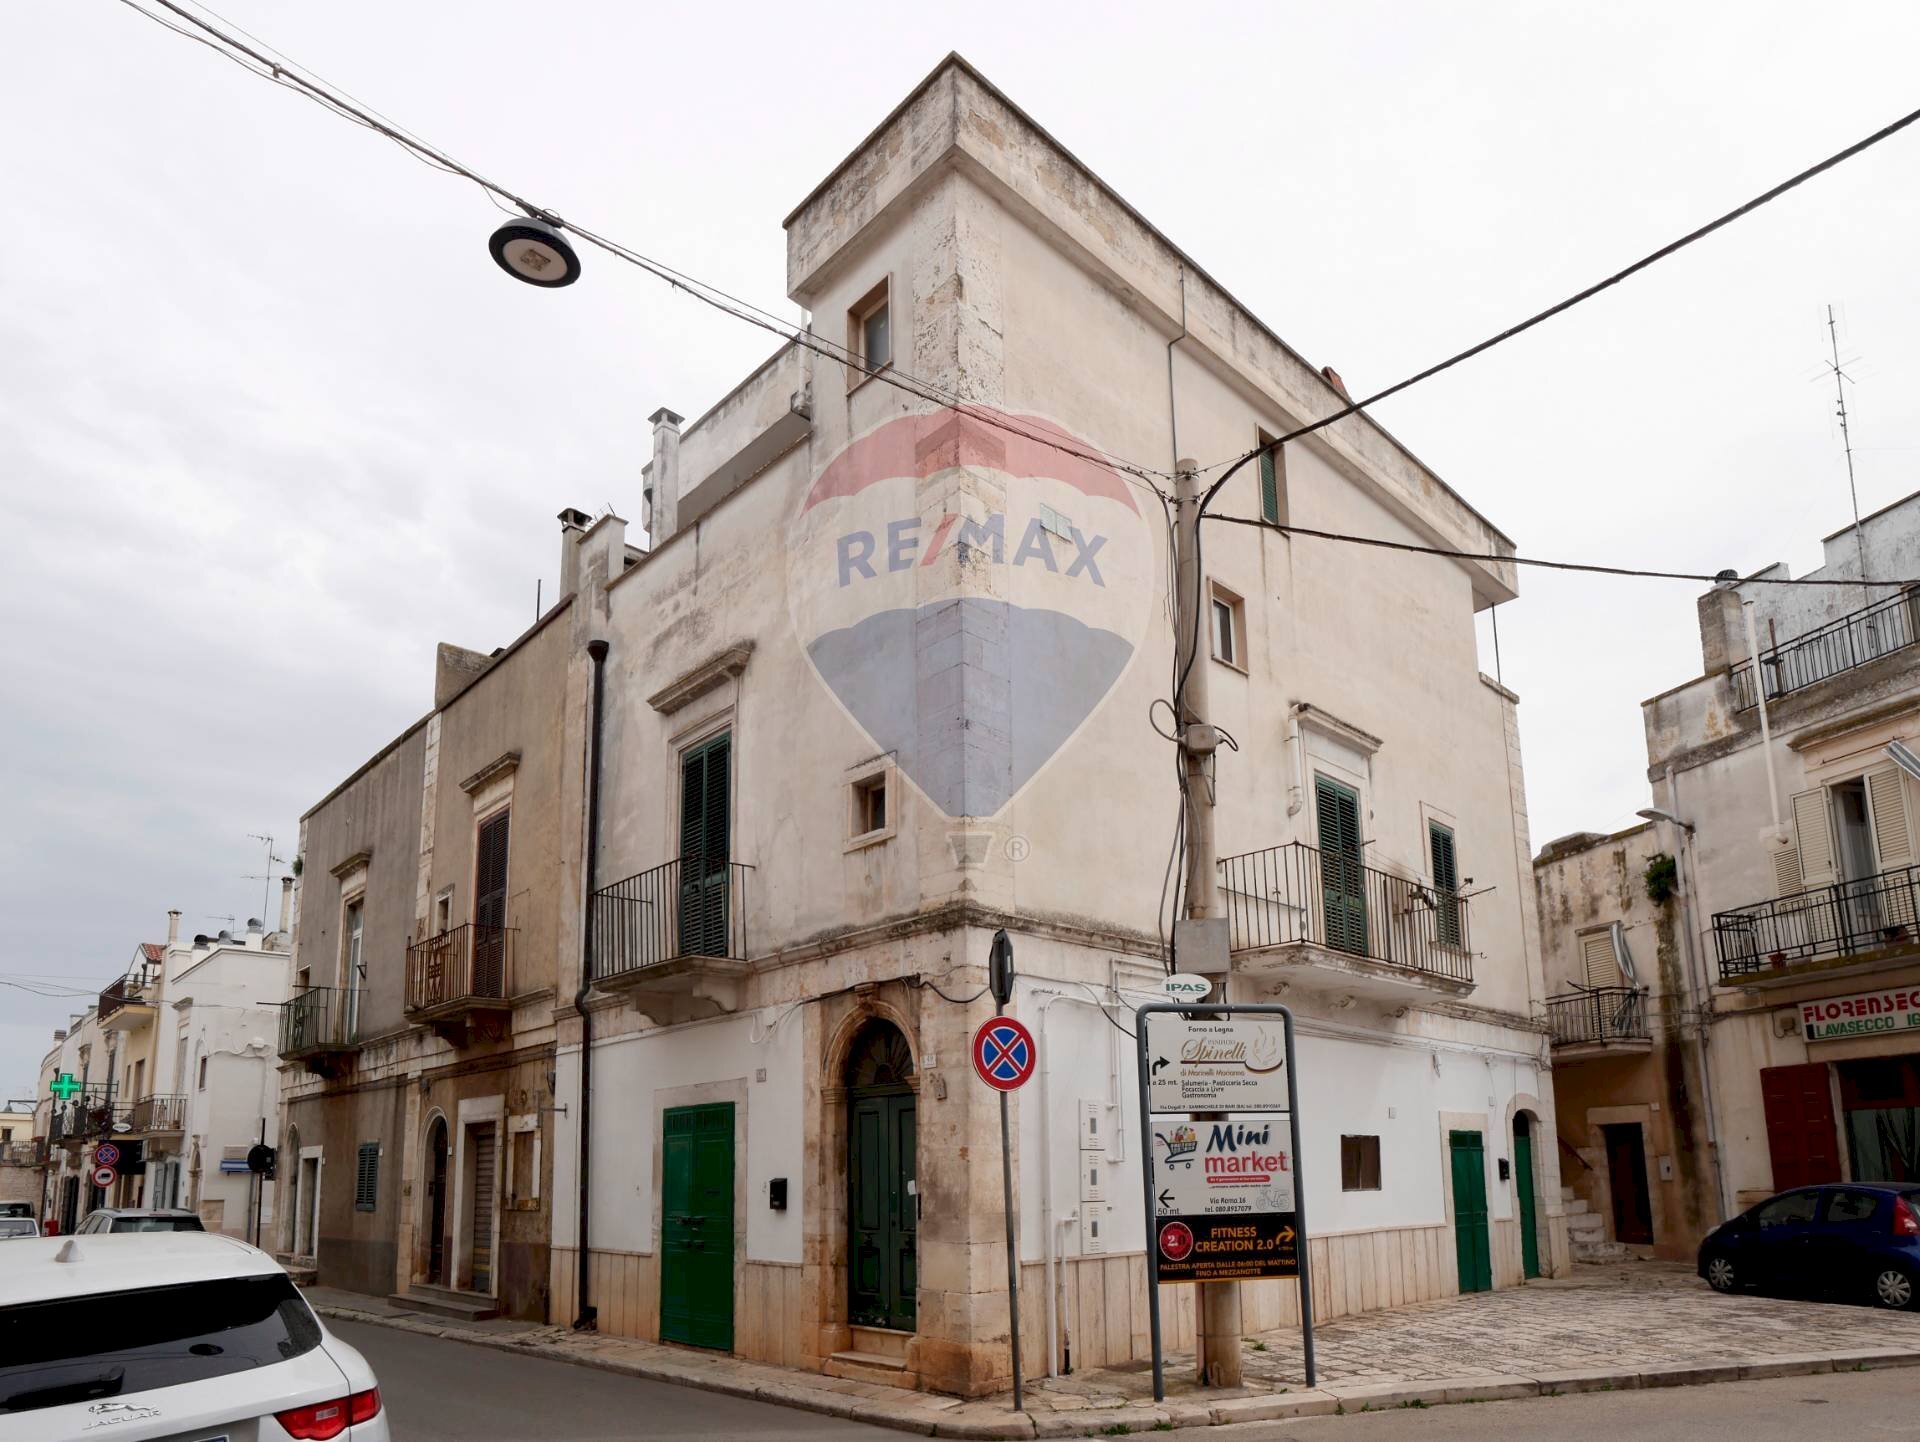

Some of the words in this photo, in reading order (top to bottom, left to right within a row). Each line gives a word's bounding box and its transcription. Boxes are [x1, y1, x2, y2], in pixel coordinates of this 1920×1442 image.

[1166, 983, 1206, 992] IPAS
[1214, 1026, 1234, 1034] Legna
[1816, 1016, 1895, 1037] LAVASECCO
[1181, 1036, 1247, 1066] Spinelli
[1182, 1079, 1208, 1087] Salumeria
[1212, 1079, 1241, 1087] Pasticceria
[1242, 1079, 1258, 1087] Secca
[1206, 1124, 1270, 1153] Mini
[1204, 1151, 1288, 1173] market
[1211, 1226, 1257, 1238] FITNESS
[1195, 1241, 1253, 1252] CREATION
[1257, 1240, 1273, 1250] 2.0
[1160, 1263, 1190, 1271] PALESTRA
[1267, 1258, 1296, 1266] MATTINO
[1219, 1268, 1262, 1276] MEZZANOTTE
[82, 1410, 162, 1431] JAGUAR
